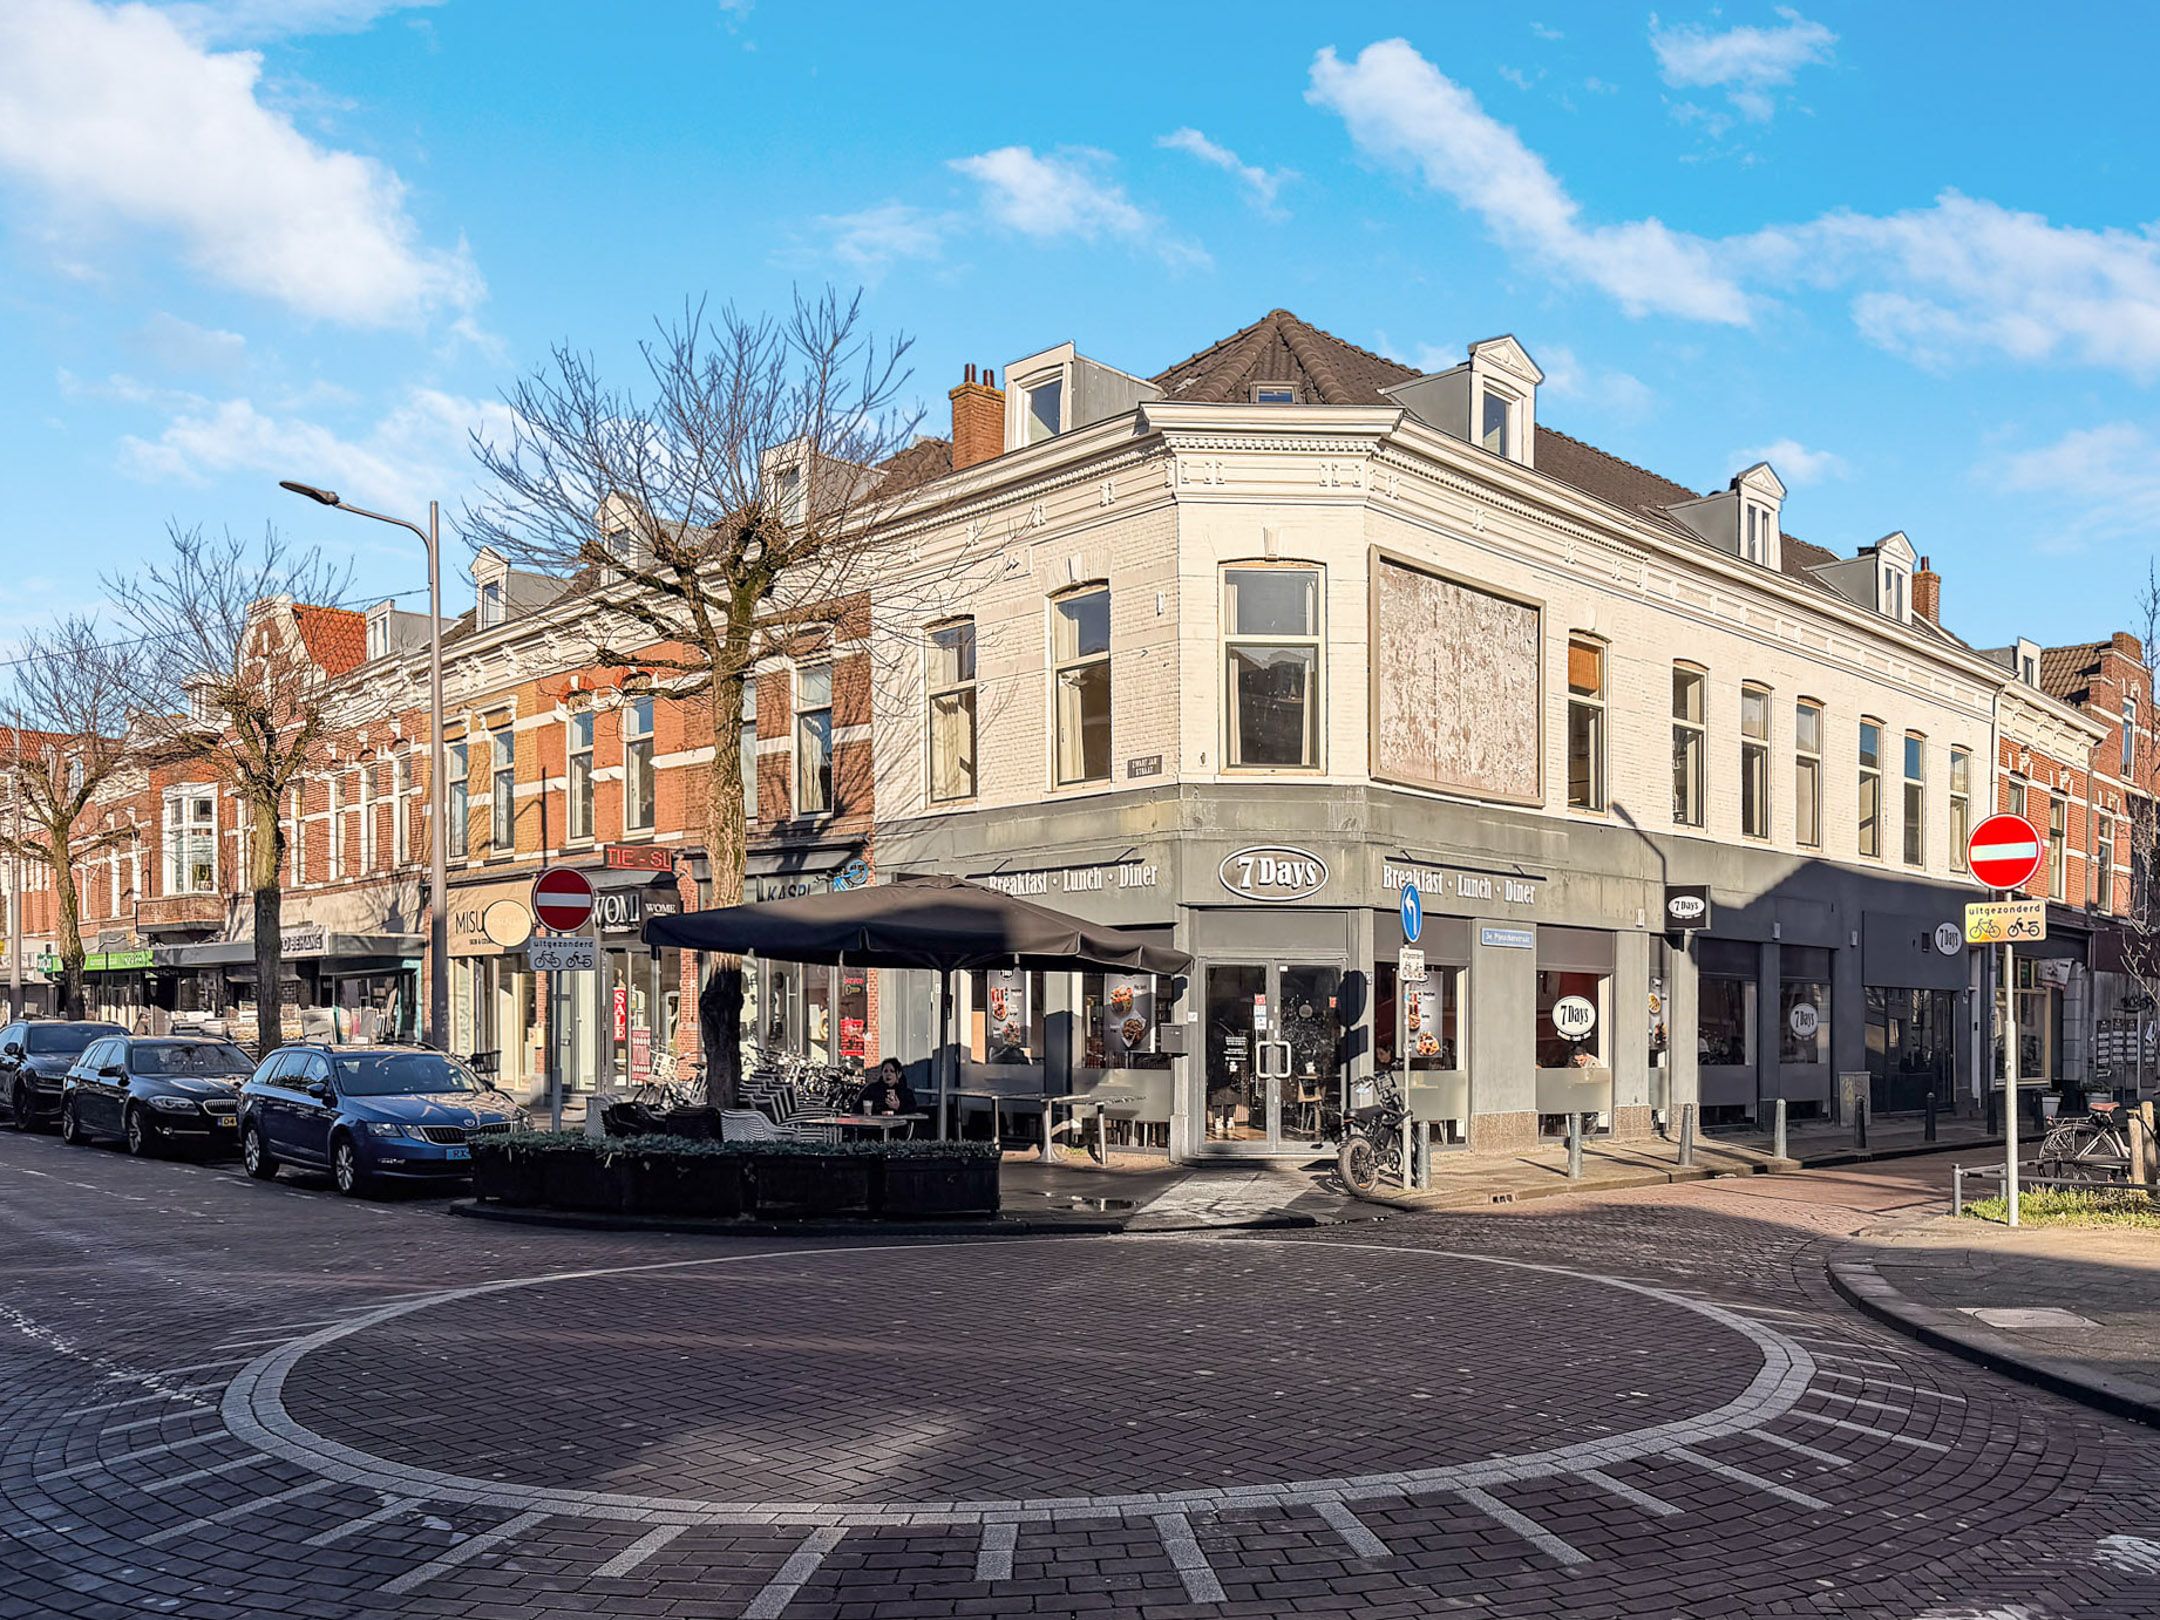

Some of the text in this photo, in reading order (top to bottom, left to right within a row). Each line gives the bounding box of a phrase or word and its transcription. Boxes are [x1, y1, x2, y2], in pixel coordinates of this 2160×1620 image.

[1062, 867, 1102, 892] Lunch
[1118, 863, 1158, 887] Diner
[1258, 857, 1316, 889] Days
[1383, 864, 1536, 905] Breakfast Lunch Diner
[1968, 904, 2040, 916] uitgezonderd
[533, 941, 594, 949] uitgezonderd
[613, 991, 627, 1039] SALE
[1568, 1005, 1589, 1026] Days
